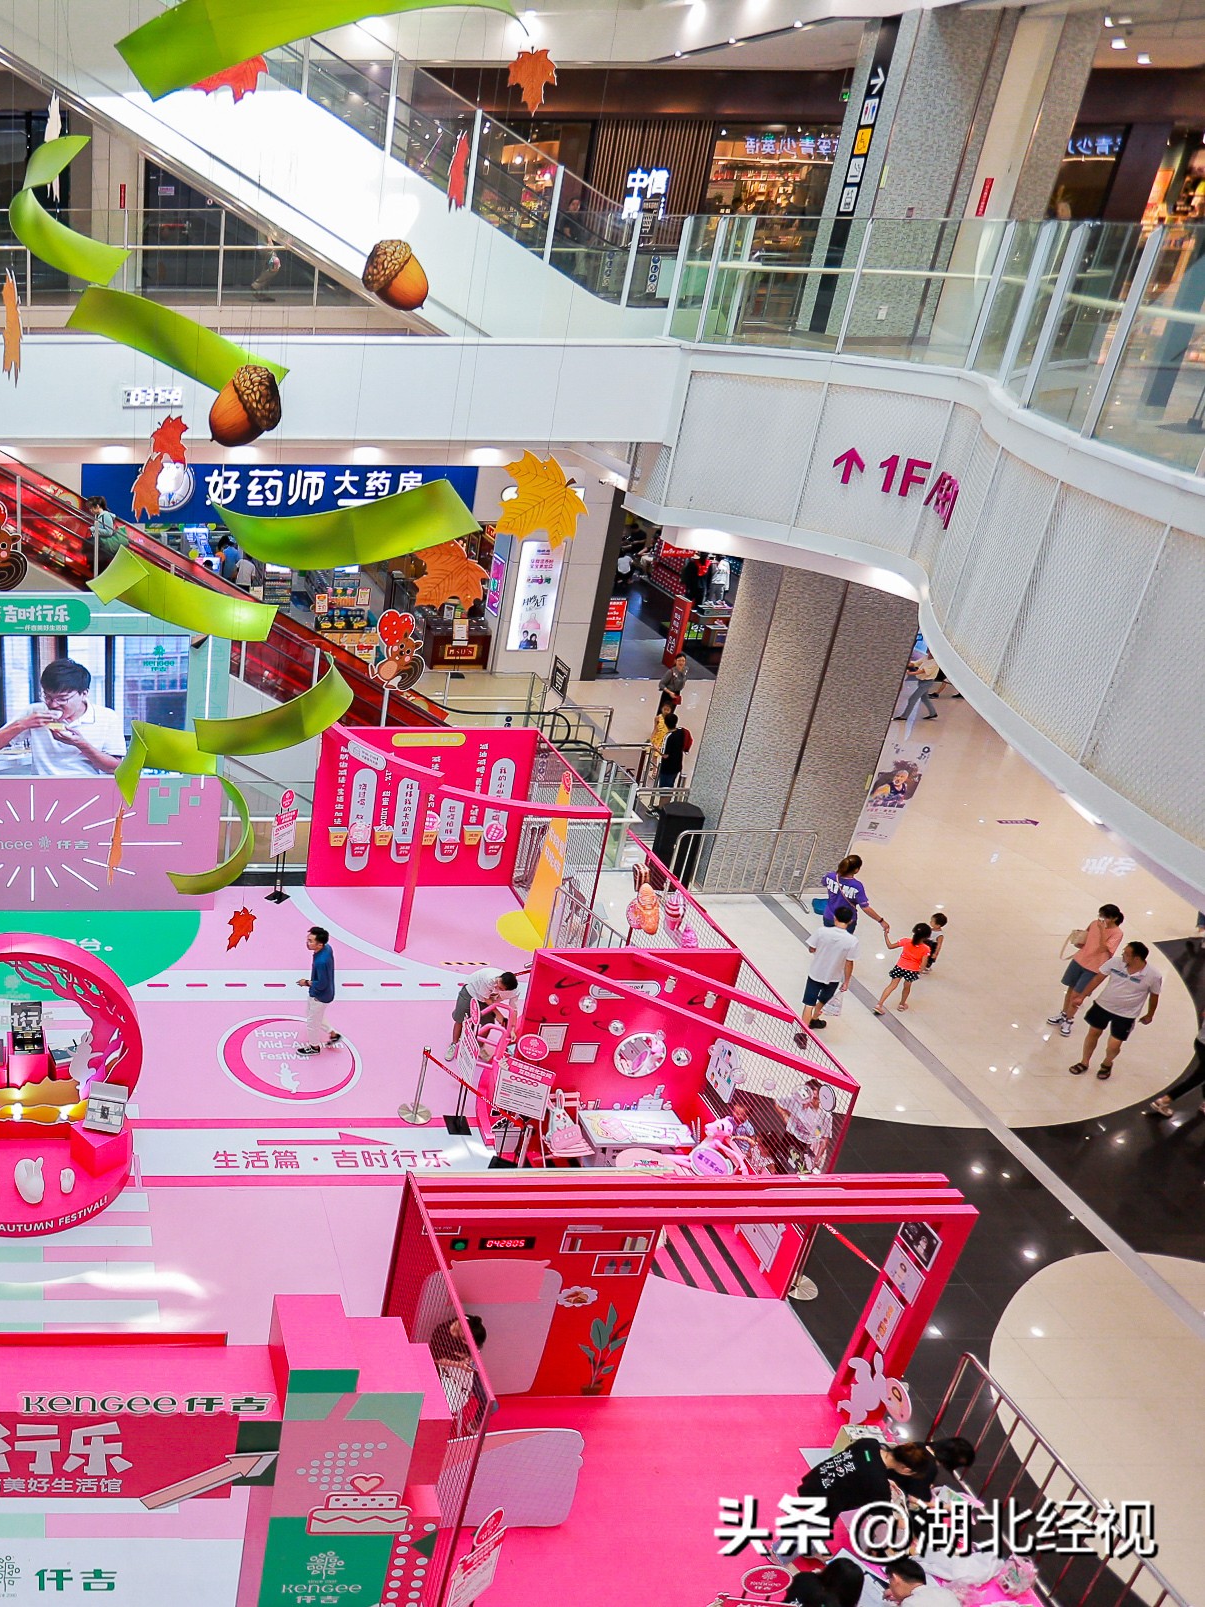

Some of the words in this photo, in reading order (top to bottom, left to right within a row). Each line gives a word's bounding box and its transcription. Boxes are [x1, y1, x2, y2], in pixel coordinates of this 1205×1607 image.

[879, 454, 933, 497] 1F
[205, 468, 326, 507] 好药师
[333, 469, 424, 499] 大药房
[3, 604, 71, 623] 吉时行乐
[56, 840, 90, 850] 仟吉
[254, 1029, 299, 1042] Happy
[55, 1196, 110, 1230] FESTIVAL!
[486, 1239, 526, 1249] 042805
[22, 1395, 177, 1415] Kengee
[183, 1395, 273, 1414] 仟吉
[35, 1567, 117, 1592] 仟吉
[281, 1583, 362, 1594] Kengee
[296, 1595, 340, 1604] 仟吉
